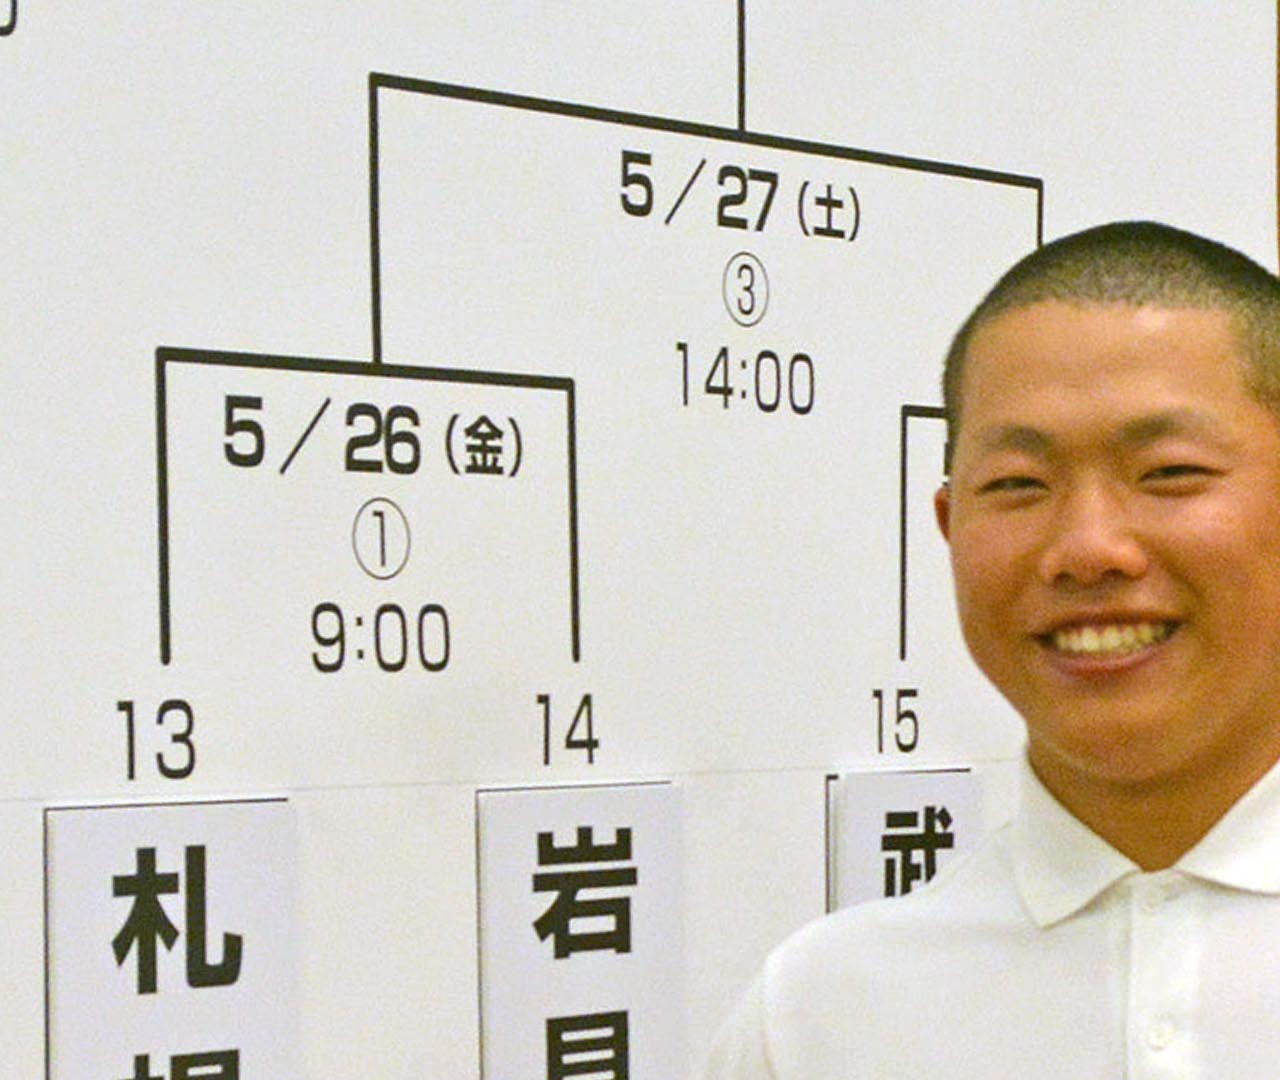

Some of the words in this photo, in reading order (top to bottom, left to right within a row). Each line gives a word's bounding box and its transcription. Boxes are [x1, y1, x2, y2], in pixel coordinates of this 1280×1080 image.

[675, 341, 816, 416] 14:00
[310, 601, 451, 674] 9:00
[116, 698, 197, 781] 13
[536, 693, 600, 767] 14
[872, 687, 920, 754] 15
